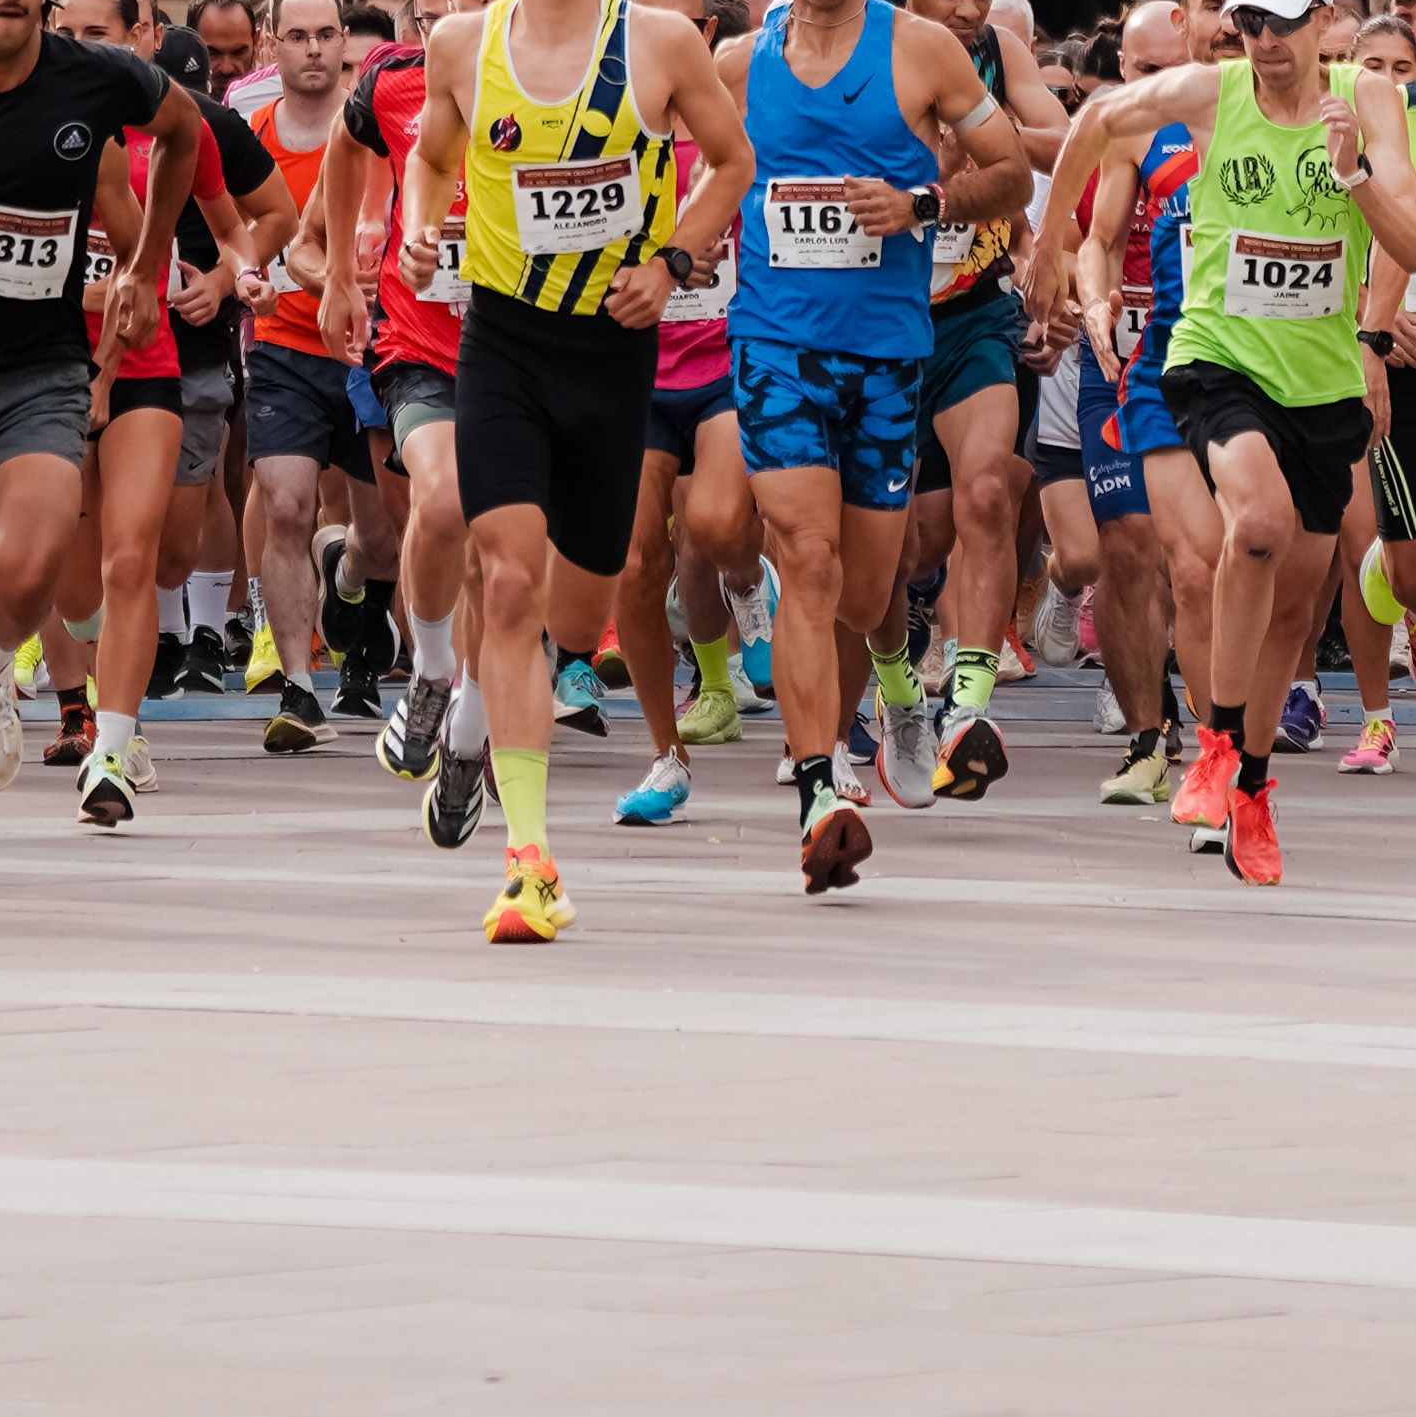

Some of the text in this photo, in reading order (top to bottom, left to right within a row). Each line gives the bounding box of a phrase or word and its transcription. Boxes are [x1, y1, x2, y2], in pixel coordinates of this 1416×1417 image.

[530, 183, 625, 220] 1229
[553, 217, 608, 230] ALEJANDRO
[794, 237, 849, 245] CARLOS LUIS
[1242, 259, 1333, 290] 1024
[1094, 475, 1132, 497] ADM
